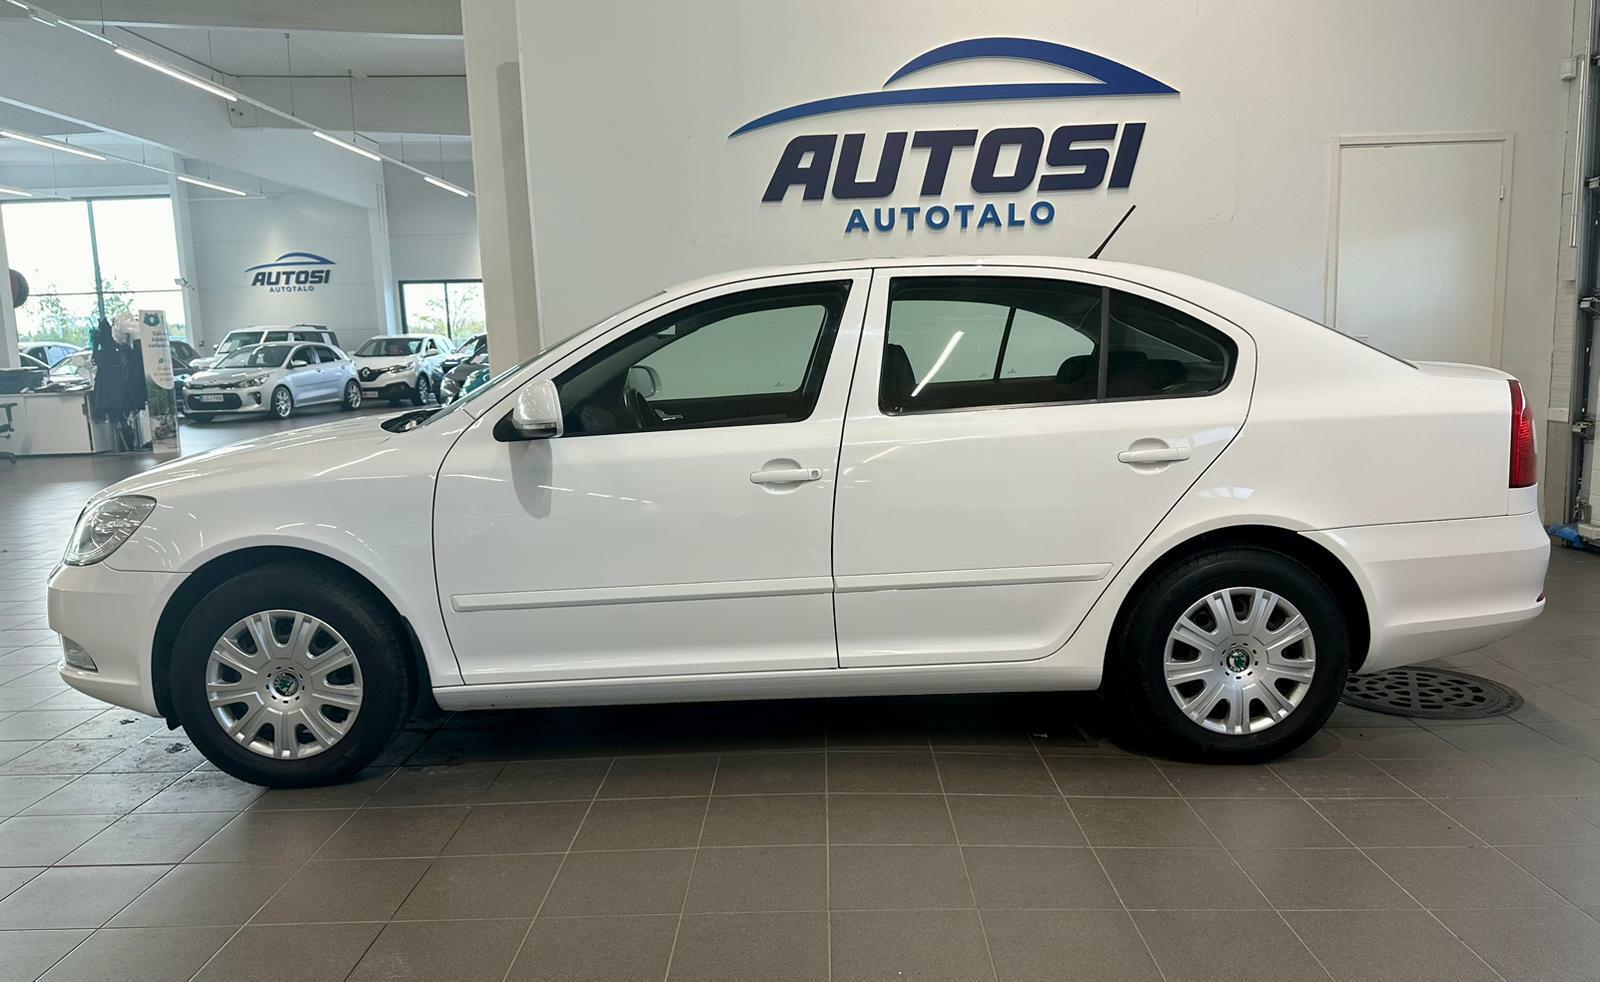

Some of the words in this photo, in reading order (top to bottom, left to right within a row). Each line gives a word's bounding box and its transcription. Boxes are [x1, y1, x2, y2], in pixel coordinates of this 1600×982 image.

[761, 122, 1147, 204] AUTOSI
[844, 200, 1056, 234] AUTOTALO
[251, 269, 331, 286] AUTOSI
[269, 285, 314, 293] AUTOTALO
